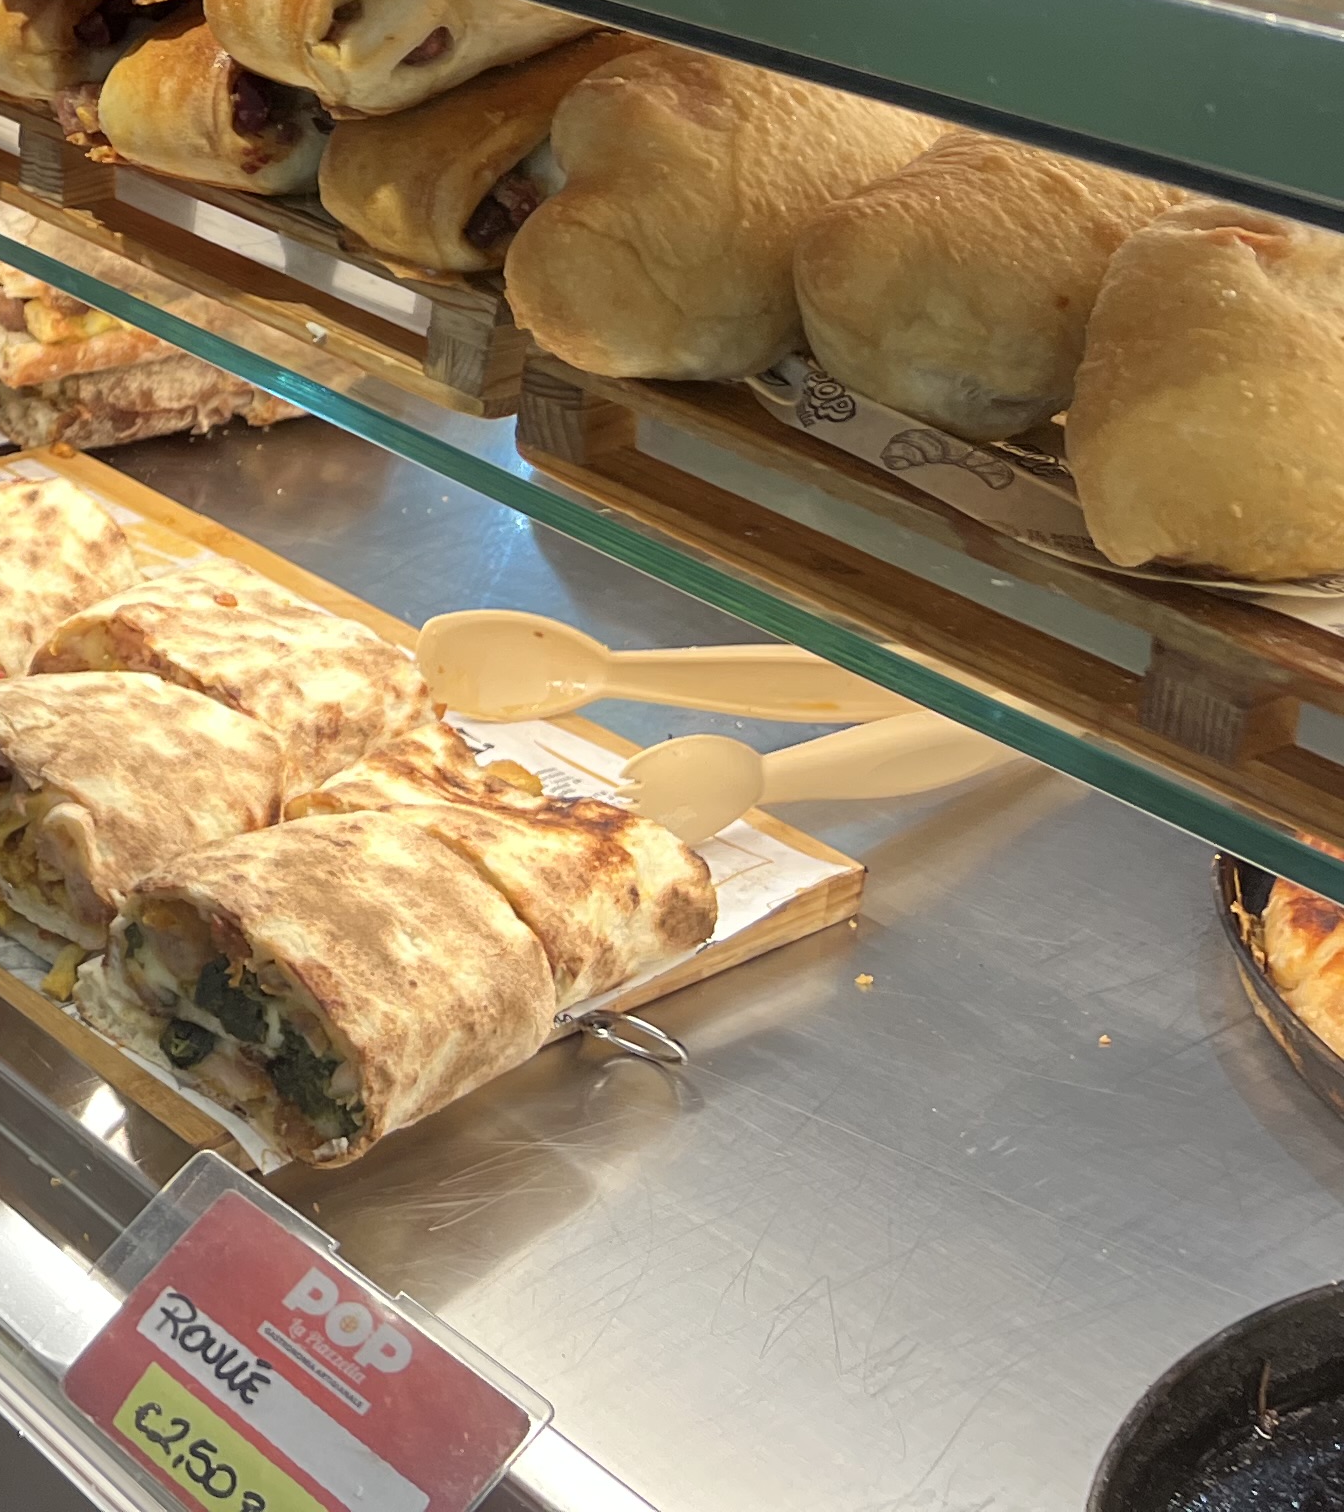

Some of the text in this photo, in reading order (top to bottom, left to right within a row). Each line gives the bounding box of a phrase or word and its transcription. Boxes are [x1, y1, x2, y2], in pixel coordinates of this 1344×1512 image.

[282, 1266, 412, 1373] POP
[305, 1326, 366, 1385] Piazzetta
[264, 1326, 363, 1408] GASTRONOMIA ARTIGIANALE
